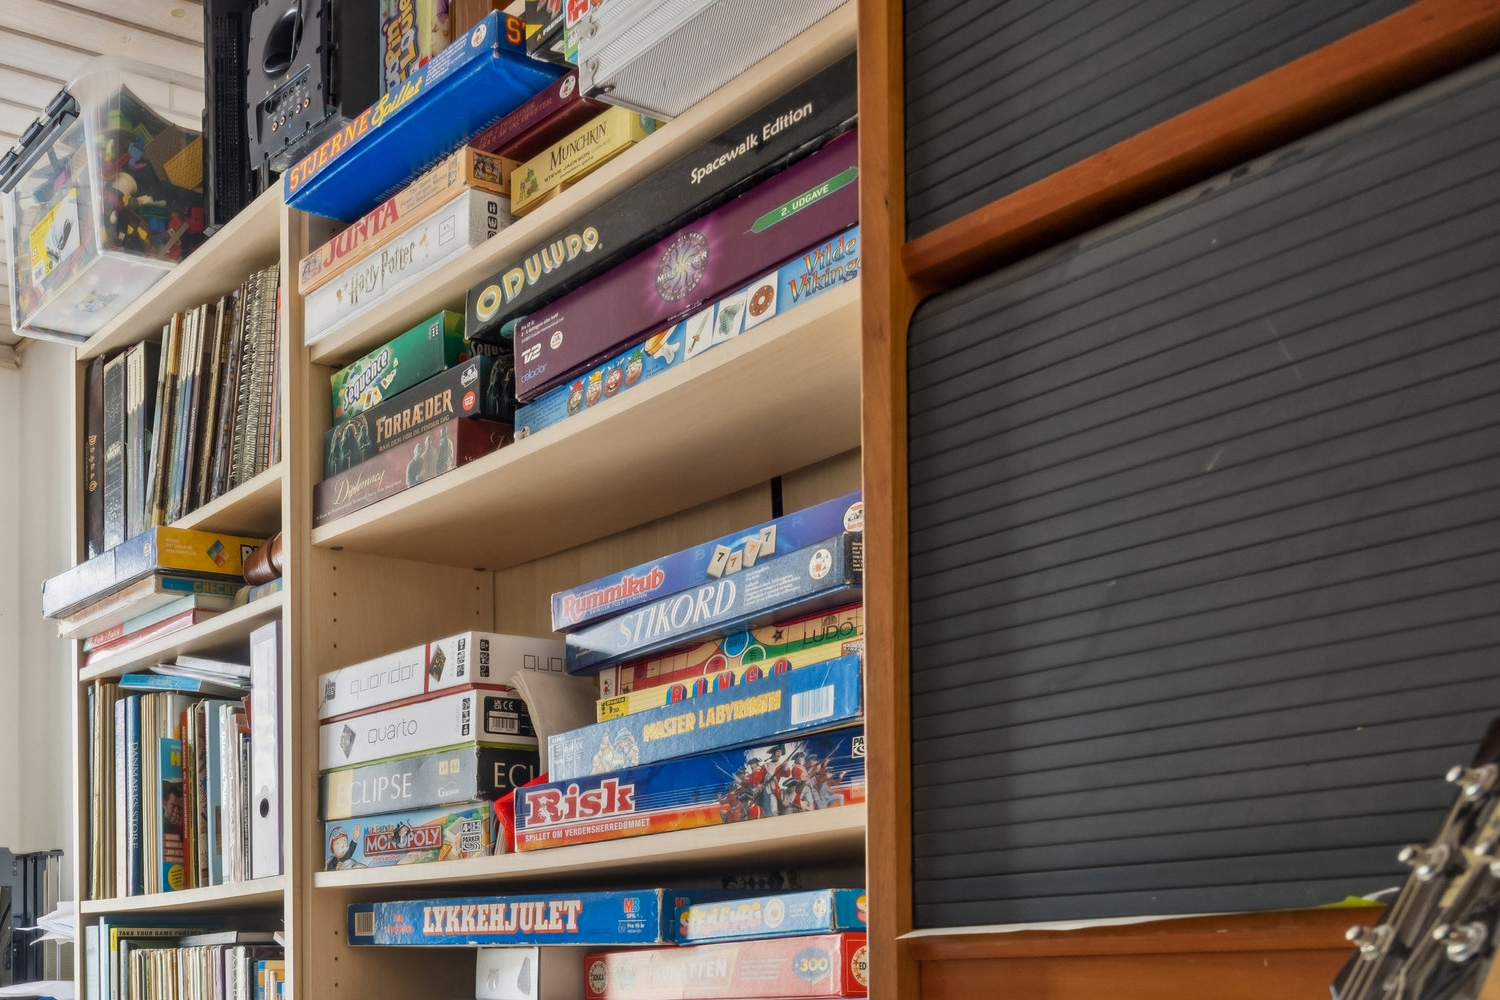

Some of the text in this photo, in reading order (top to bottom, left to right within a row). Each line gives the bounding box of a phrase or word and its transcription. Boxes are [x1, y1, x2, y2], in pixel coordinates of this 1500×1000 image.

[290, 77, 423, 191] STJERNE Spillet
[549, 121, 607, 171] MUNCHKIN
[691, 102, 813, 185] Spacewalk Edition
[544, 151, 591, 183] STEVE JACKSON
[781, 184, 830, 217] 2. UDGAVE
[323, 197, 400, 268] JUNTA
[349, 242, 417, 304] Harry Potter
[803, 236, 857, 276] Vilde
[343, 349, 390, 410] Sequence
[375, 388, 454, 444] FORRÆDER
[333, 467, 386, 505] Diplomacy
[764, 530, 772, 542] 7
[715, 550, 726, 563] 7
[561, 565, 665, 623] Rummikub
[618, 578, 737, 650] STIKORD
[803, 621, 854, 645] LUDO
[349, 661, 420, 696] quoridor
[666, 657, 793, 707] BINGO
[367, 718, 418, 746] quarto
[642, 689, 782, 744] MASTER LABYRINTH
[131, 741, 139, 850] DANMARKS STORE
[337, 772, 413, 807] ECLIPSE
[525, 778, 635, 828] Risk
[462, 835, 481, 843] PARKER
[525, 817, 651, 844] SPILLET OM VERDENSHERREDØMMET
[422, 899, 583, 936] LYKKEHJULET
[623, 897, 641, 914] MB
[593, 974, 605, 982] EDUCA
[794, 957, 829, 971] +300
